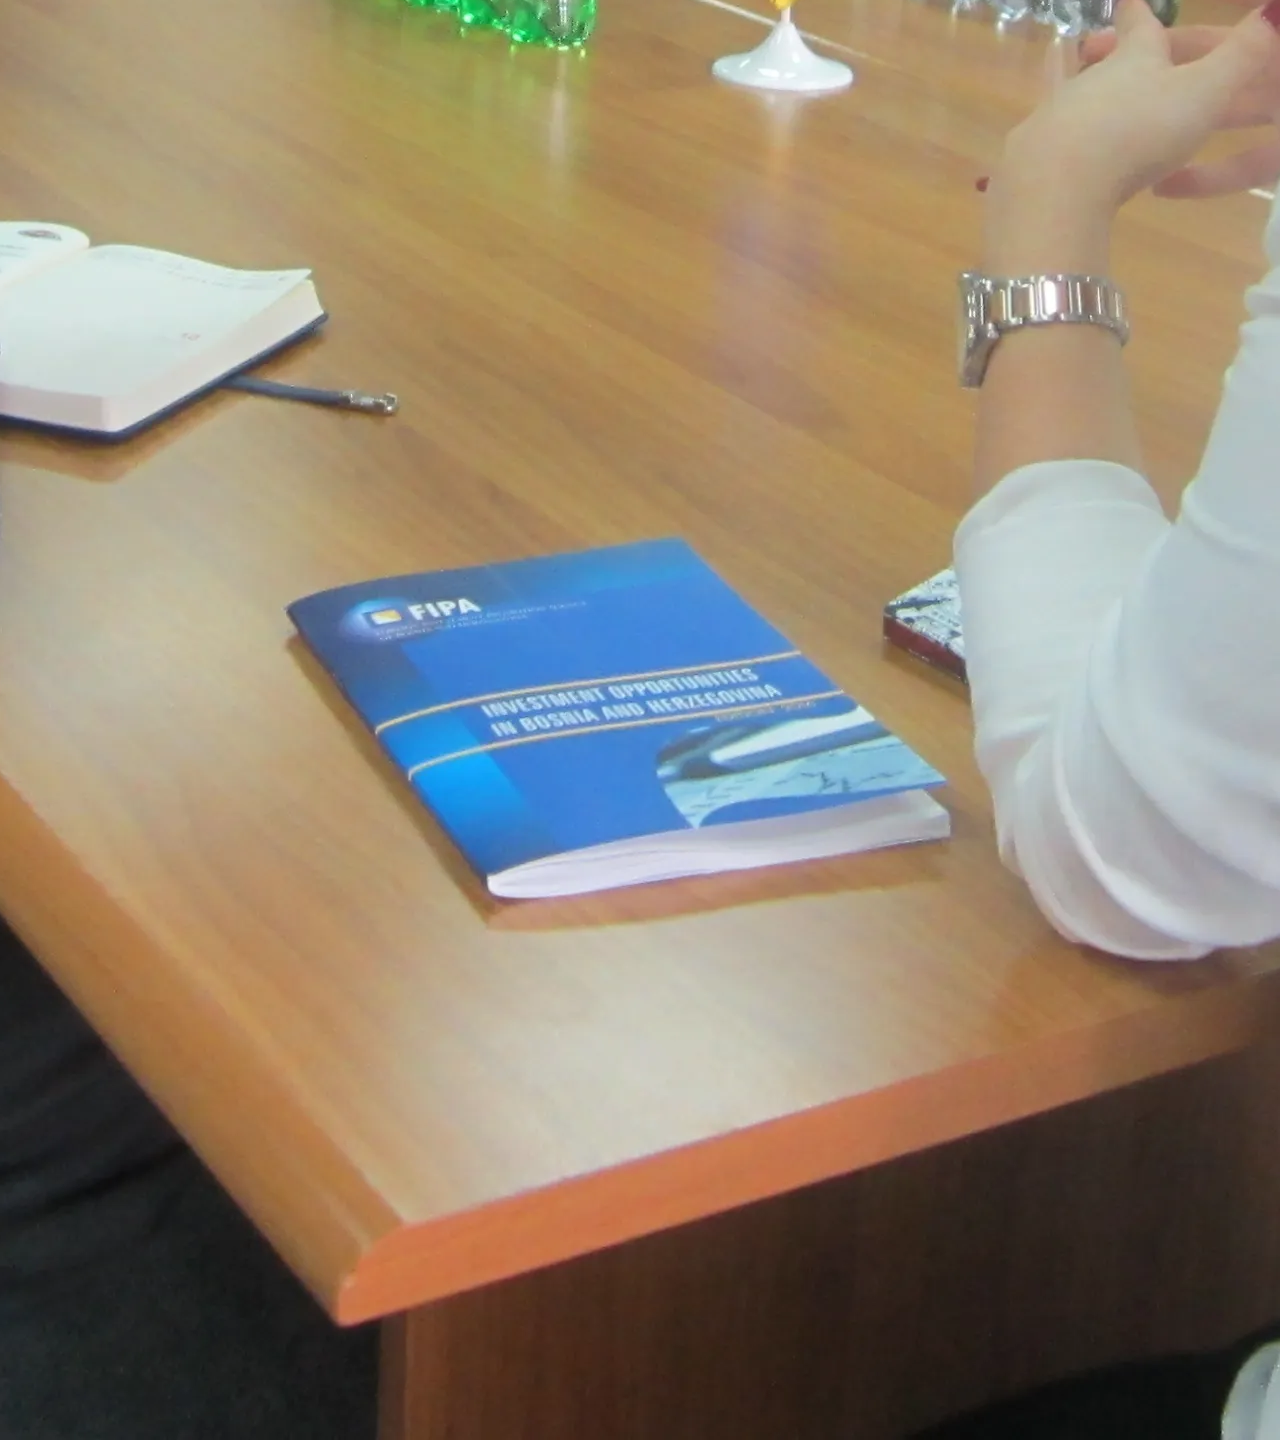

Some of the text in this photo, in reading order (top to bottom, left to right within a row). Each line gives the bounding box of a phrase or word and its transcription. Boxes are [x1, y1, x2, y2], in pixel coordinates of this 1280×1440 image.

[407, 597, 482, 621] FIPA
[481, 667, 759, 718] INVESTMENT OPPORTUNITIES
[491, 718, 518, 738] IN
[519, 708, 601, 733] BOSNIA
[601, 701, 646, 721] AND
[646, 683, 783, 716] HERZEGOVINA
